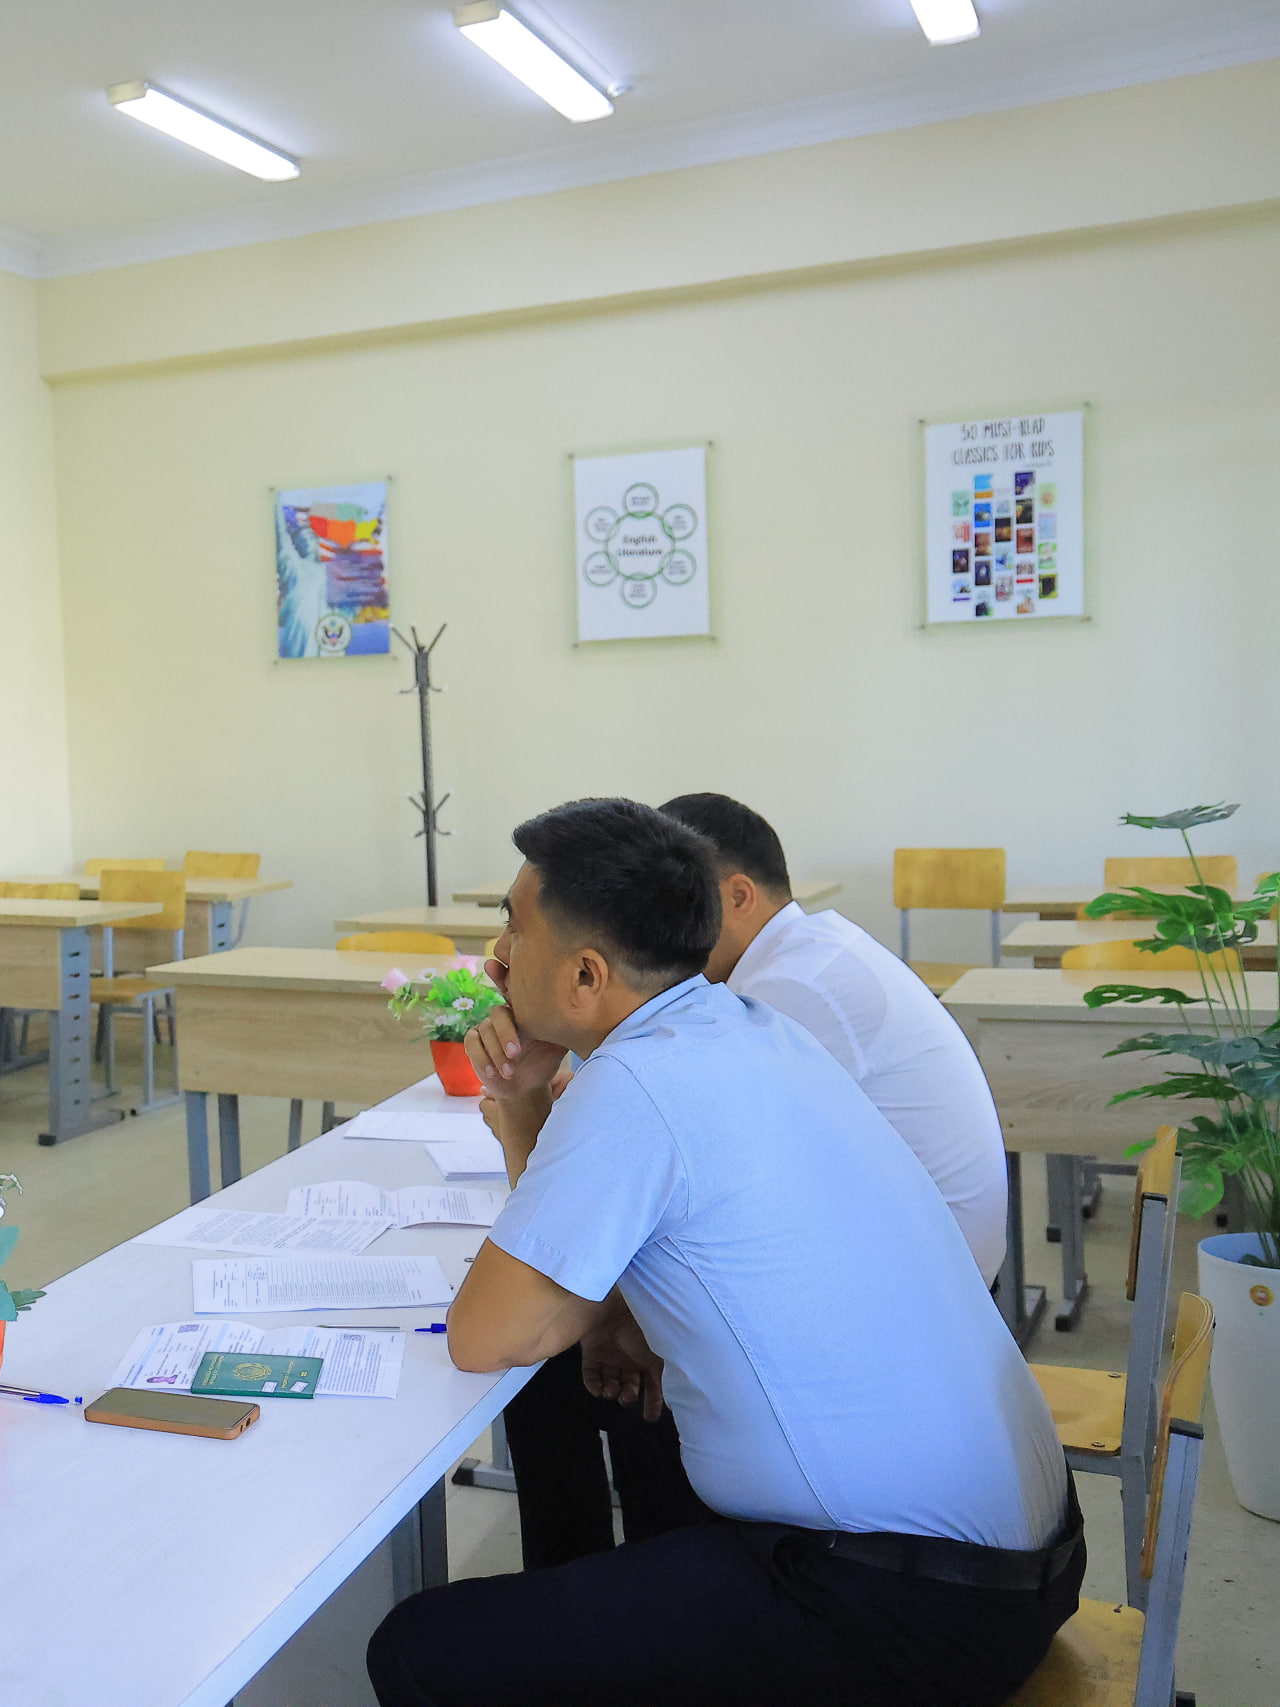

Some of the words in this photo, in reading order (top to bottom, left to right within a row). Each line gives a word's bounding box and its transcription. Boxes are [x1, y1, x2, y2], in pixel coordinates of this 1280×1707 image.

[961, 423, 978, 441] 50
[952, 444, 999, 465] CLASSICS
[1005, 441, 1025, 460] FOR
[1031, 440, 1055, 458] KIDS
[623, 535, 657, 545] English
